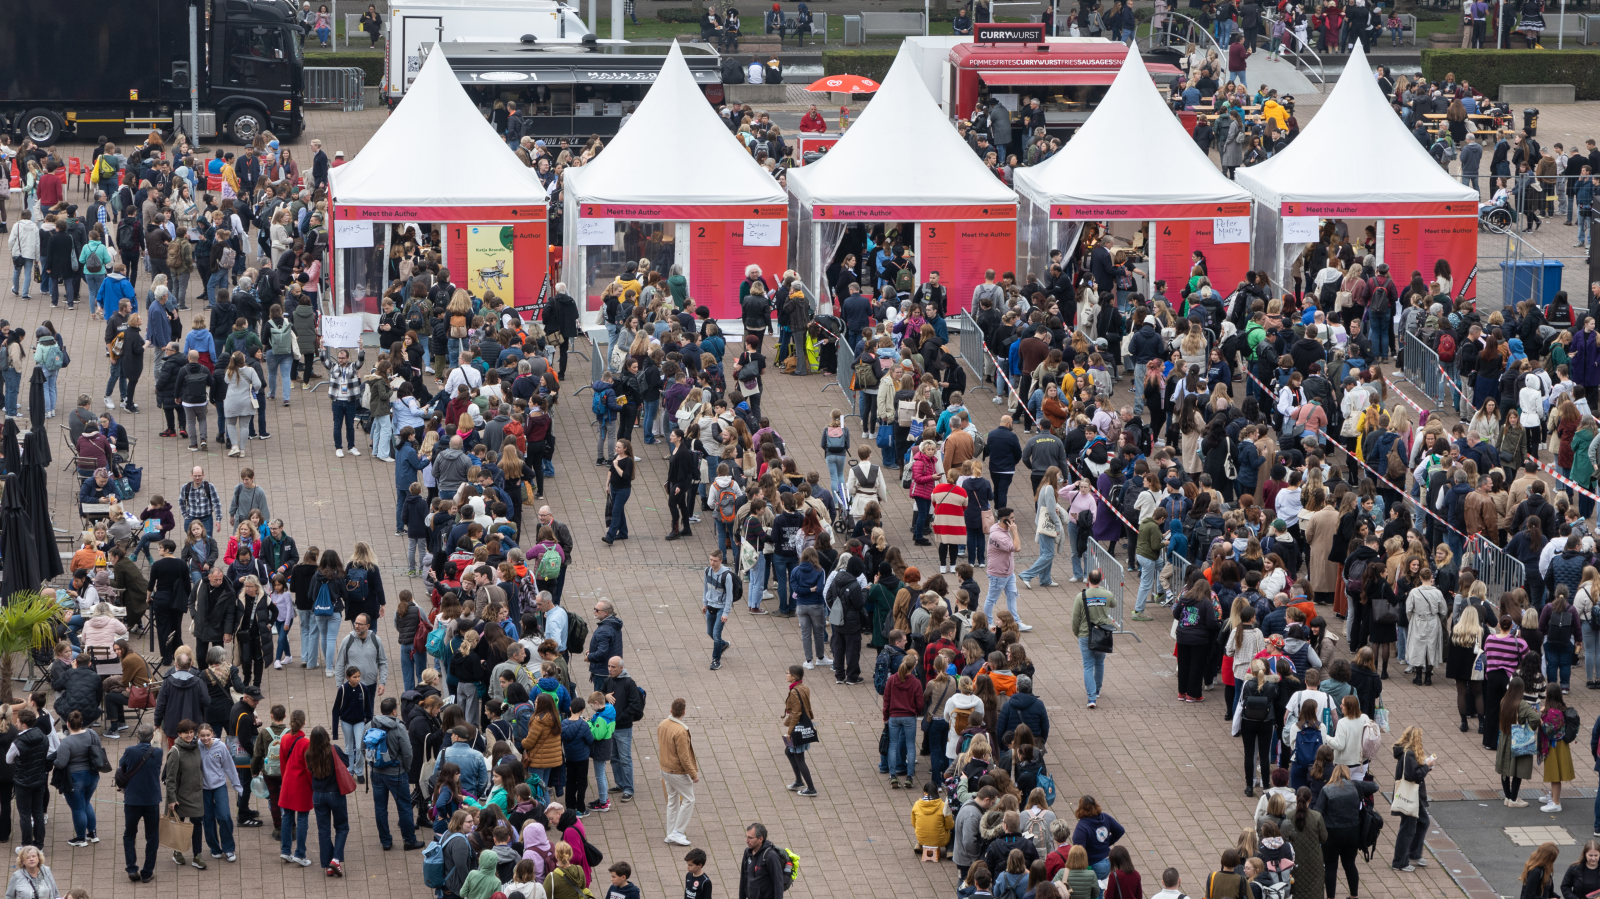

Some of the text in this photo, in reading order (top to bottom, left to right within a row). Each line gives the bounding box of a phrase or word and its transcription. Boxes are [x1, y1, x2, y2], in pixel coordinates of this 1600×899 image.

[980, 31, 1039, 39] CURRYWURST
[344, 209, 348, 217] 1
[588, 207, 593, 215] 2
[820, 208, 826, 216] 3
[1056, 208, 1062, 216] 4
[1288, 206, 1294, 214] 5
[455, 228, 460, 240] 1
[698, 226, 706, 238] 2
[928, 228, 936, 238] 3
[1163, 226, 1172, 236] 4
[1392, 224, 1400, 234] 5
[324, 317, 346, 328] Marie
[324, 330, 350, 340] Niehoff
